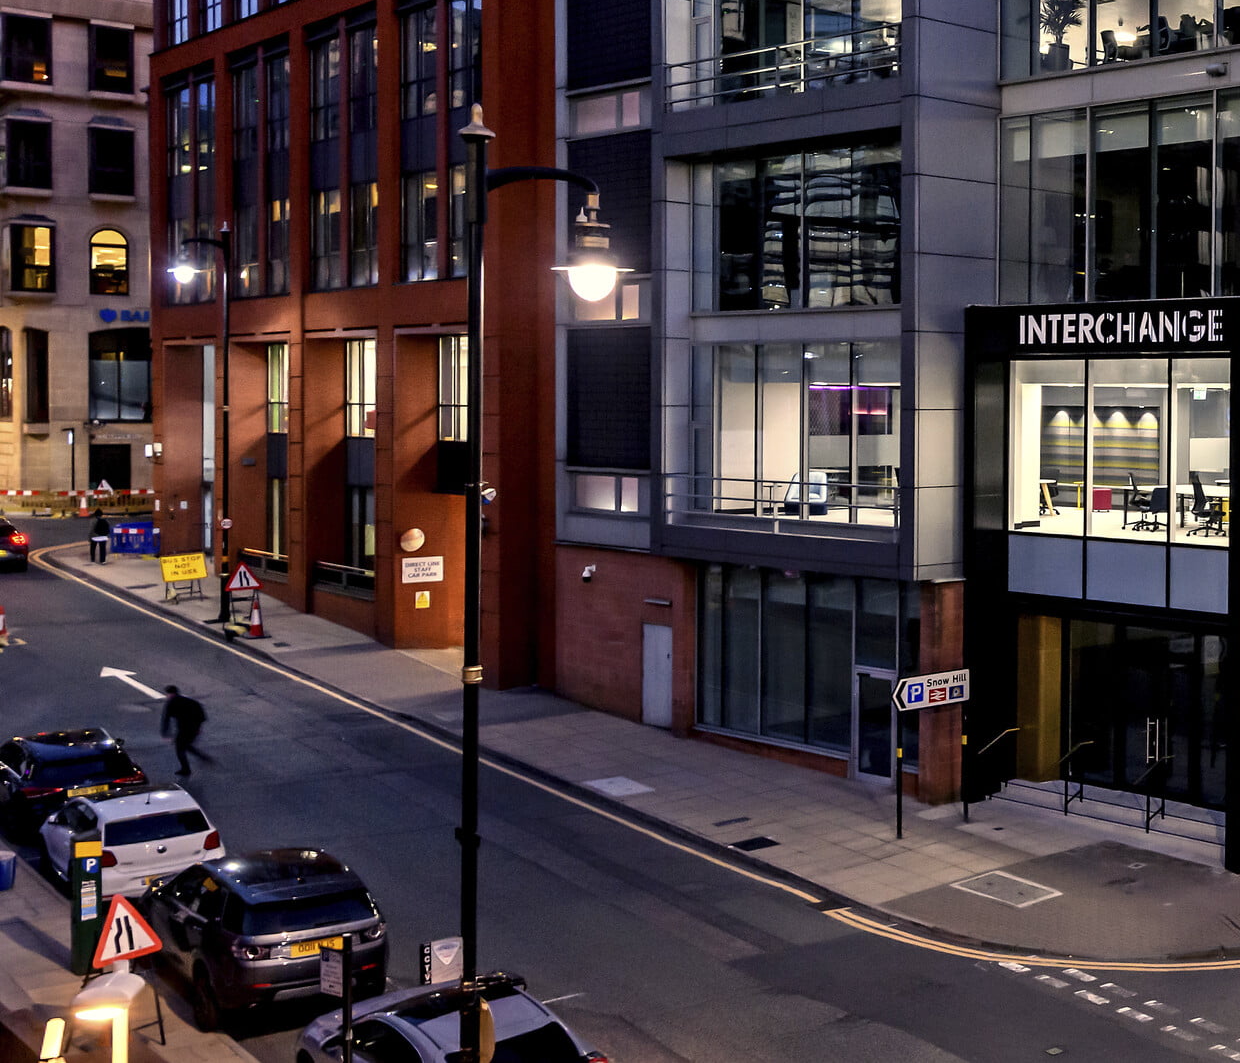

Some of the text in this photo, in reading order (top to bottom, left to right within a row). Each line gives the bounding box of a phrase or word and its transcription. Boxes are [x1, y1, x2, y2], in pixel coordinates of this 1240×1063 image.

[1019, 309, 1223, 344] INTERCHANGE
[926, 673, 967, 687] Snow Hill
[86, 858, 97, 872] P
